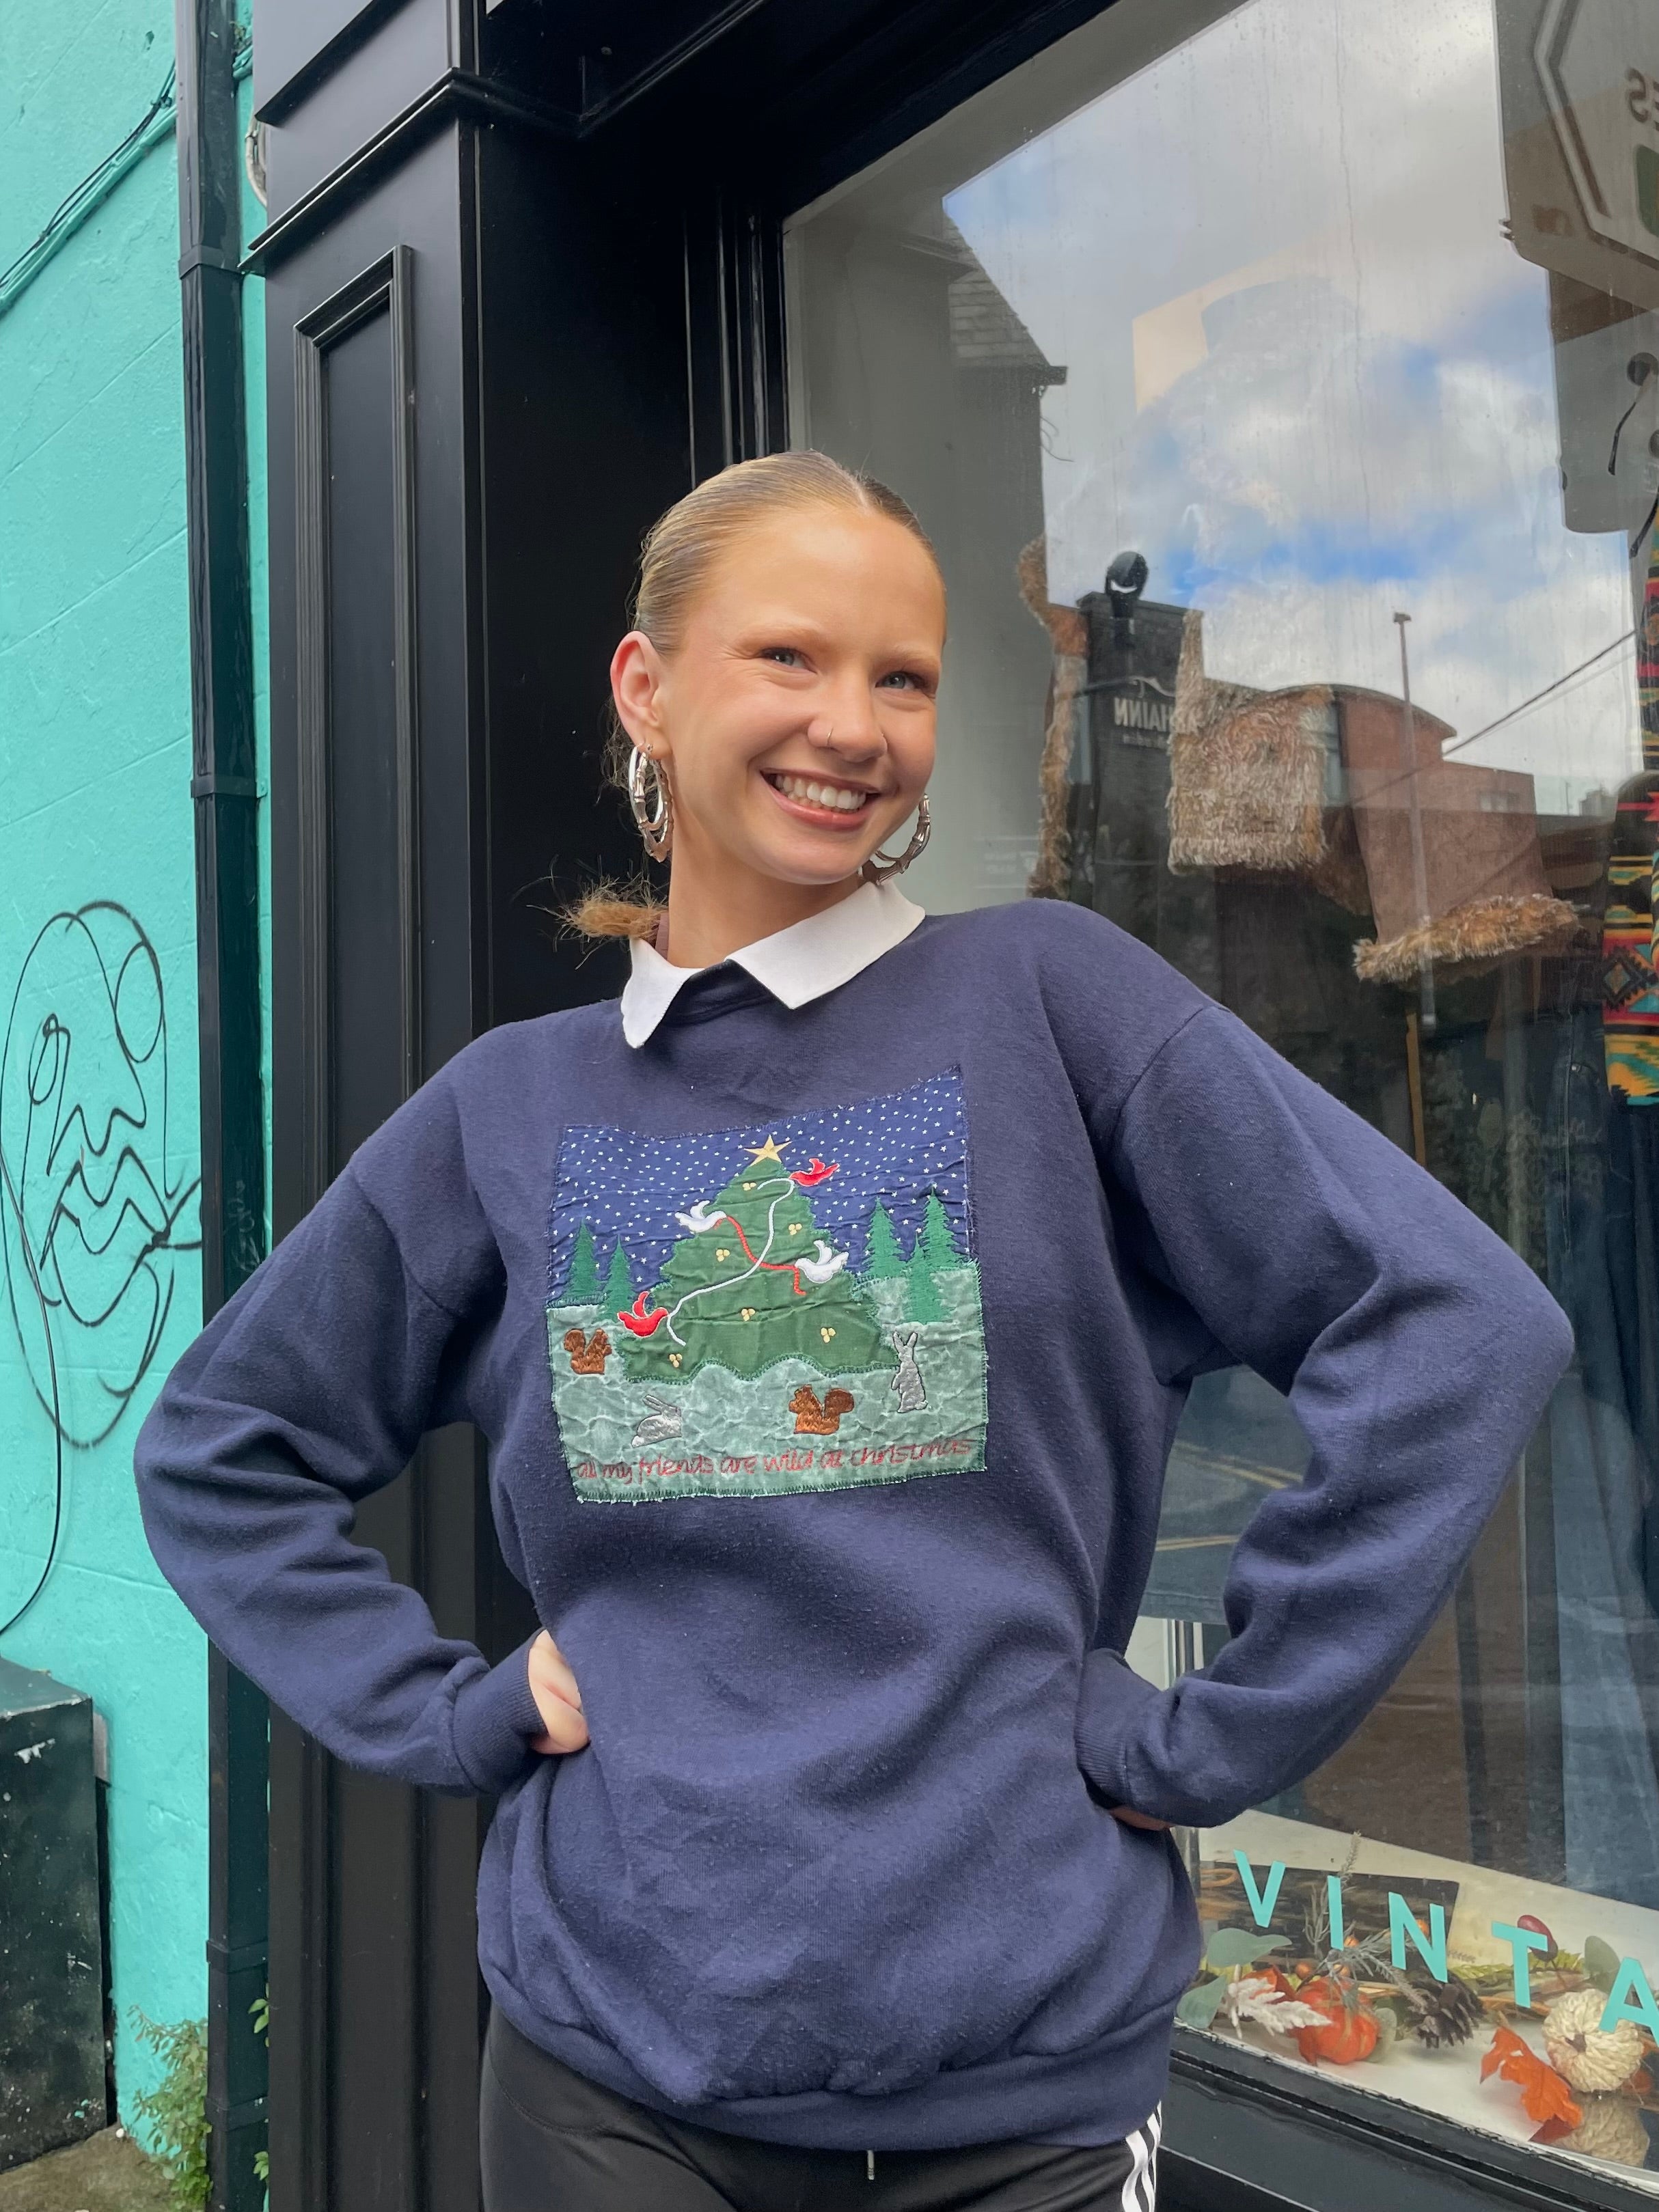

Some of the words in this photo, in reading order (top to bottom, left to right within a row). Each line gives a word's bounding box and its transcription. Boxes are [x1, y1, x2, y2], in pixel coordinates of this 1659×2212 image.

[577, 1457, 597, 1478] all
[602, 1463, 633, 1484] my
[638, 1453, 714, 1484] friends
[720, 1456, 758, 1474] are
[763, 1448, 814, 1471] wild
[821, 1449, 844, 1469] at
[1233, 1849, 1659, 2049] VINTA
